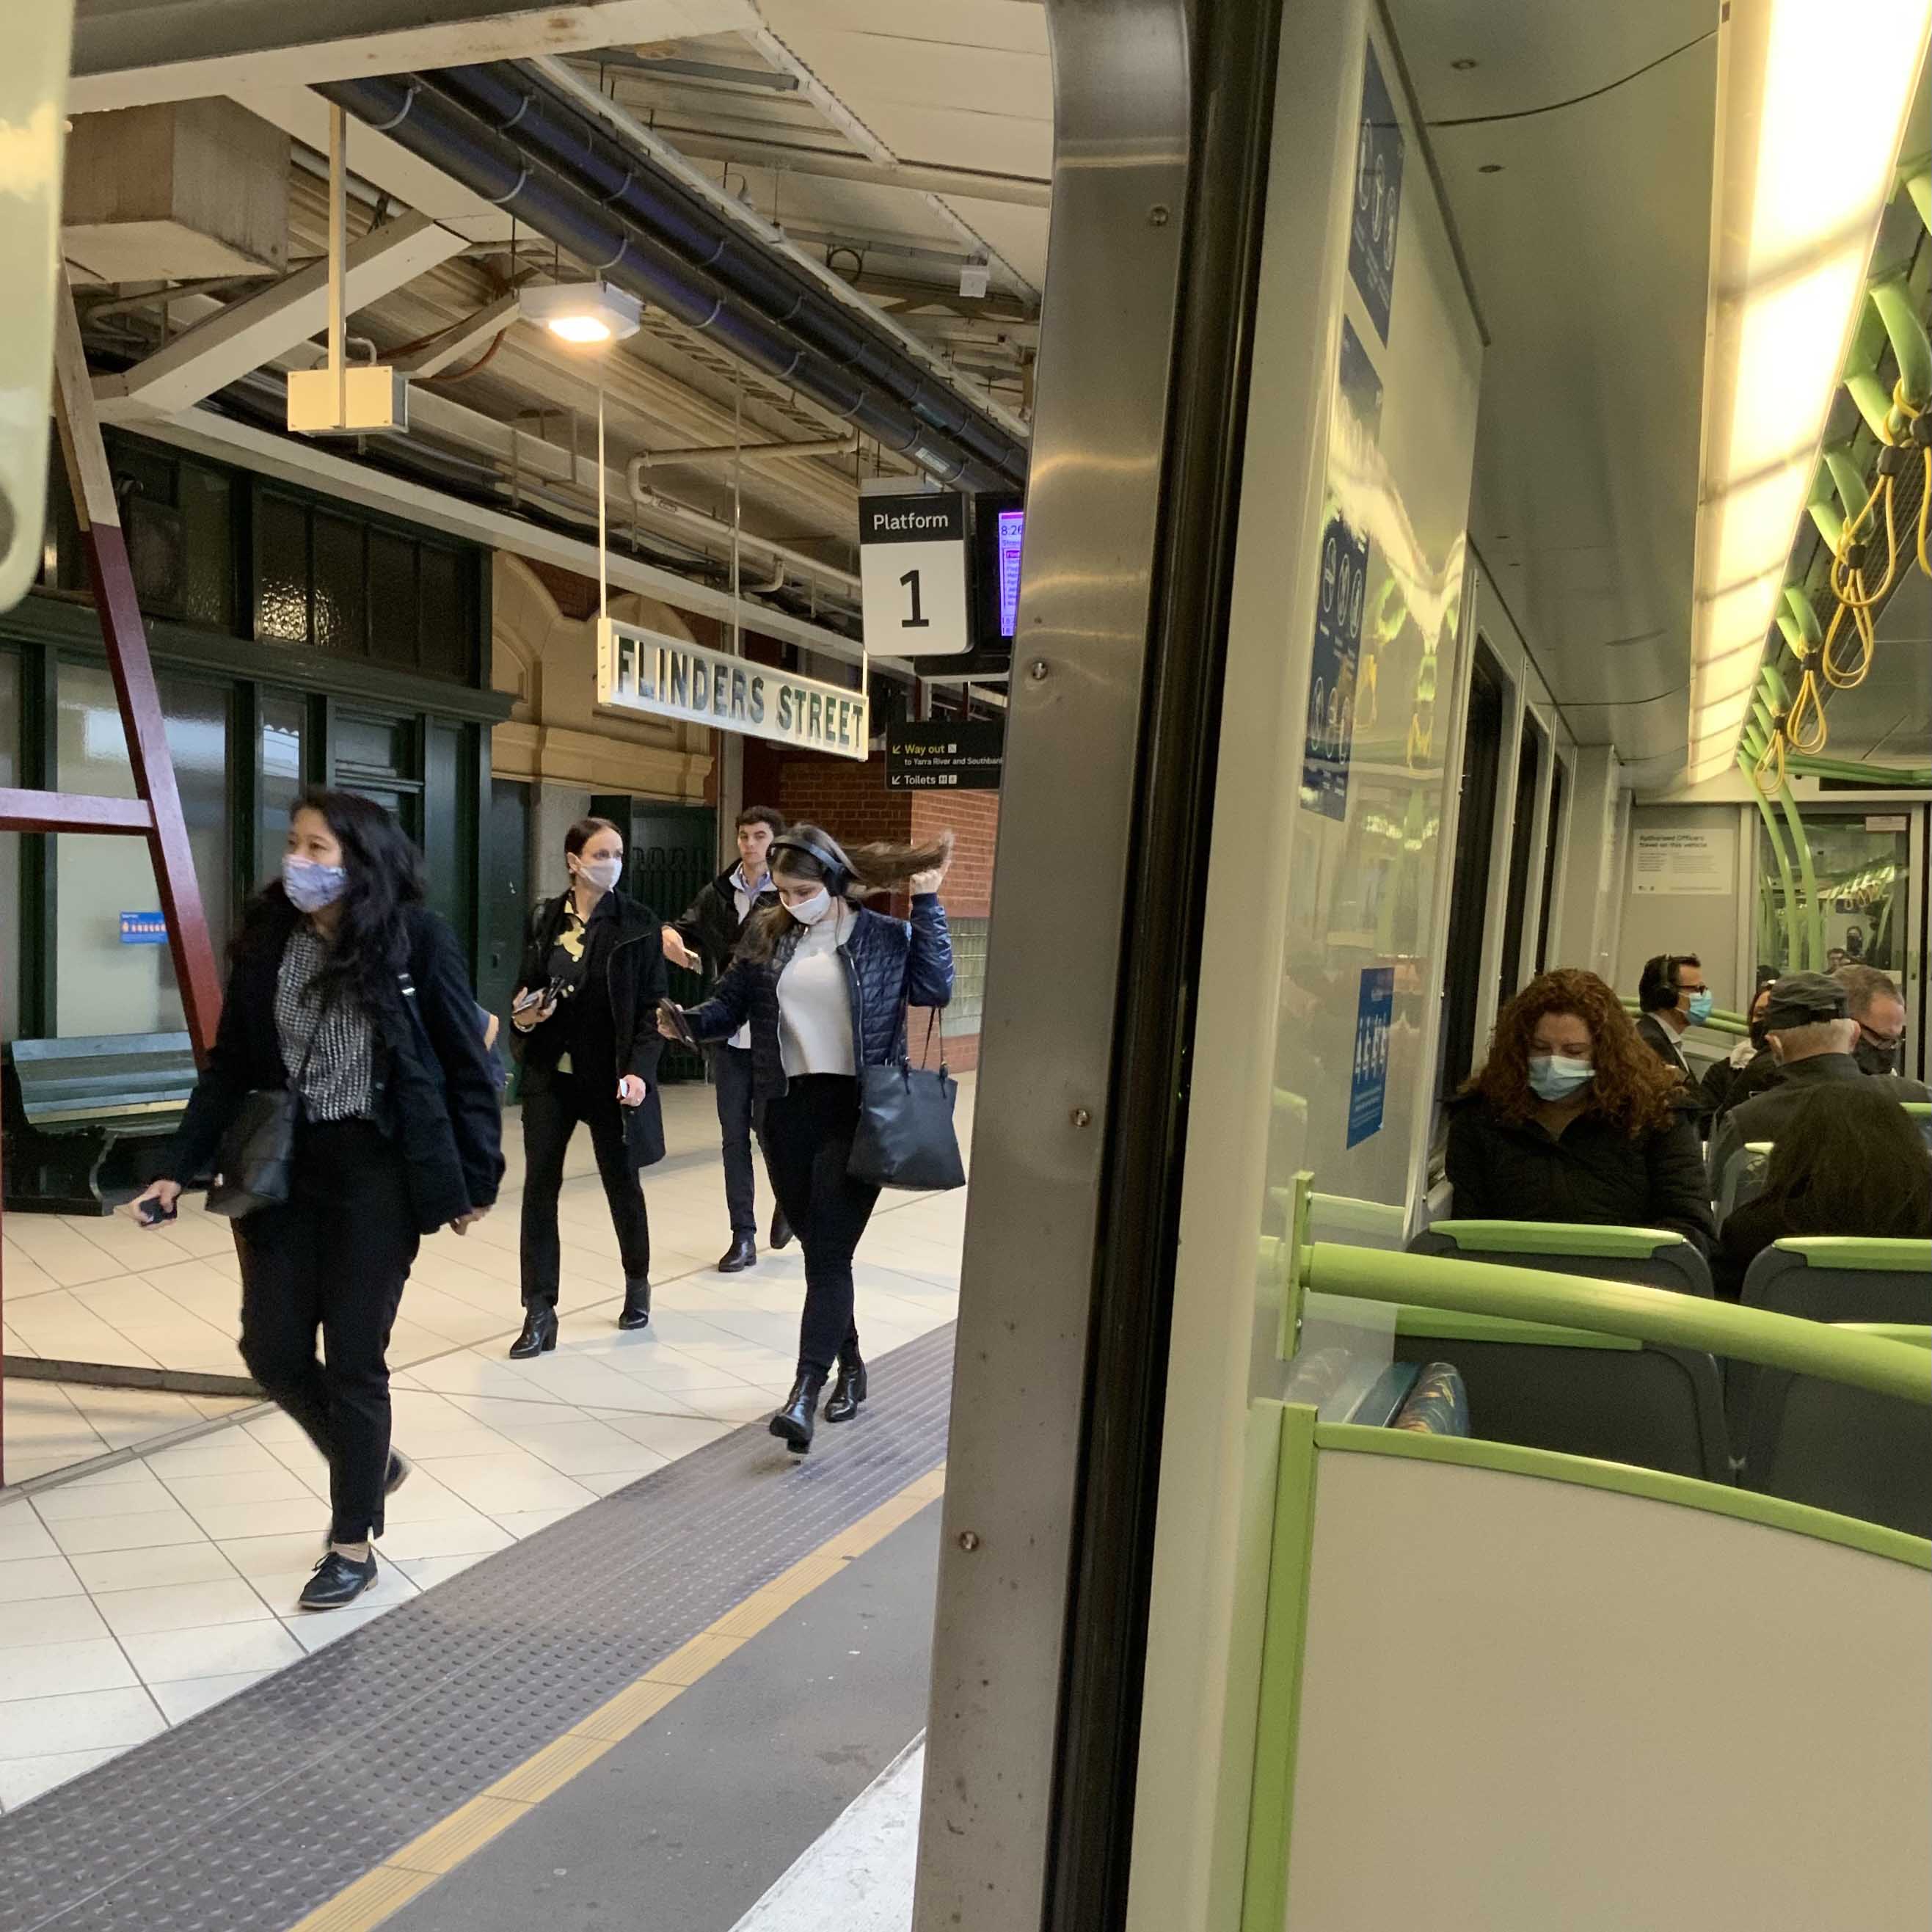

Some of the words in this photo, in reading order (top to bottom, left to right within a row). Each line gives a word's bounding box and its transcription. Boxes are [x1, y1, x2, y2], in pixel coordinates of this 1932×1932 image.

[873, 512, 949, 531] Platform
[899, 569, 930, 628] 1
[616, 635, 765, 724] FLINDERS
[776, 685, 864, 748] STREET
[904, 743, 926, 756] Way
[927, 744, 945, 754] out
[933, 757, 950, 765] River
[952, 757, 966, 765] and
[903, 775, 936, 785] Toilets
